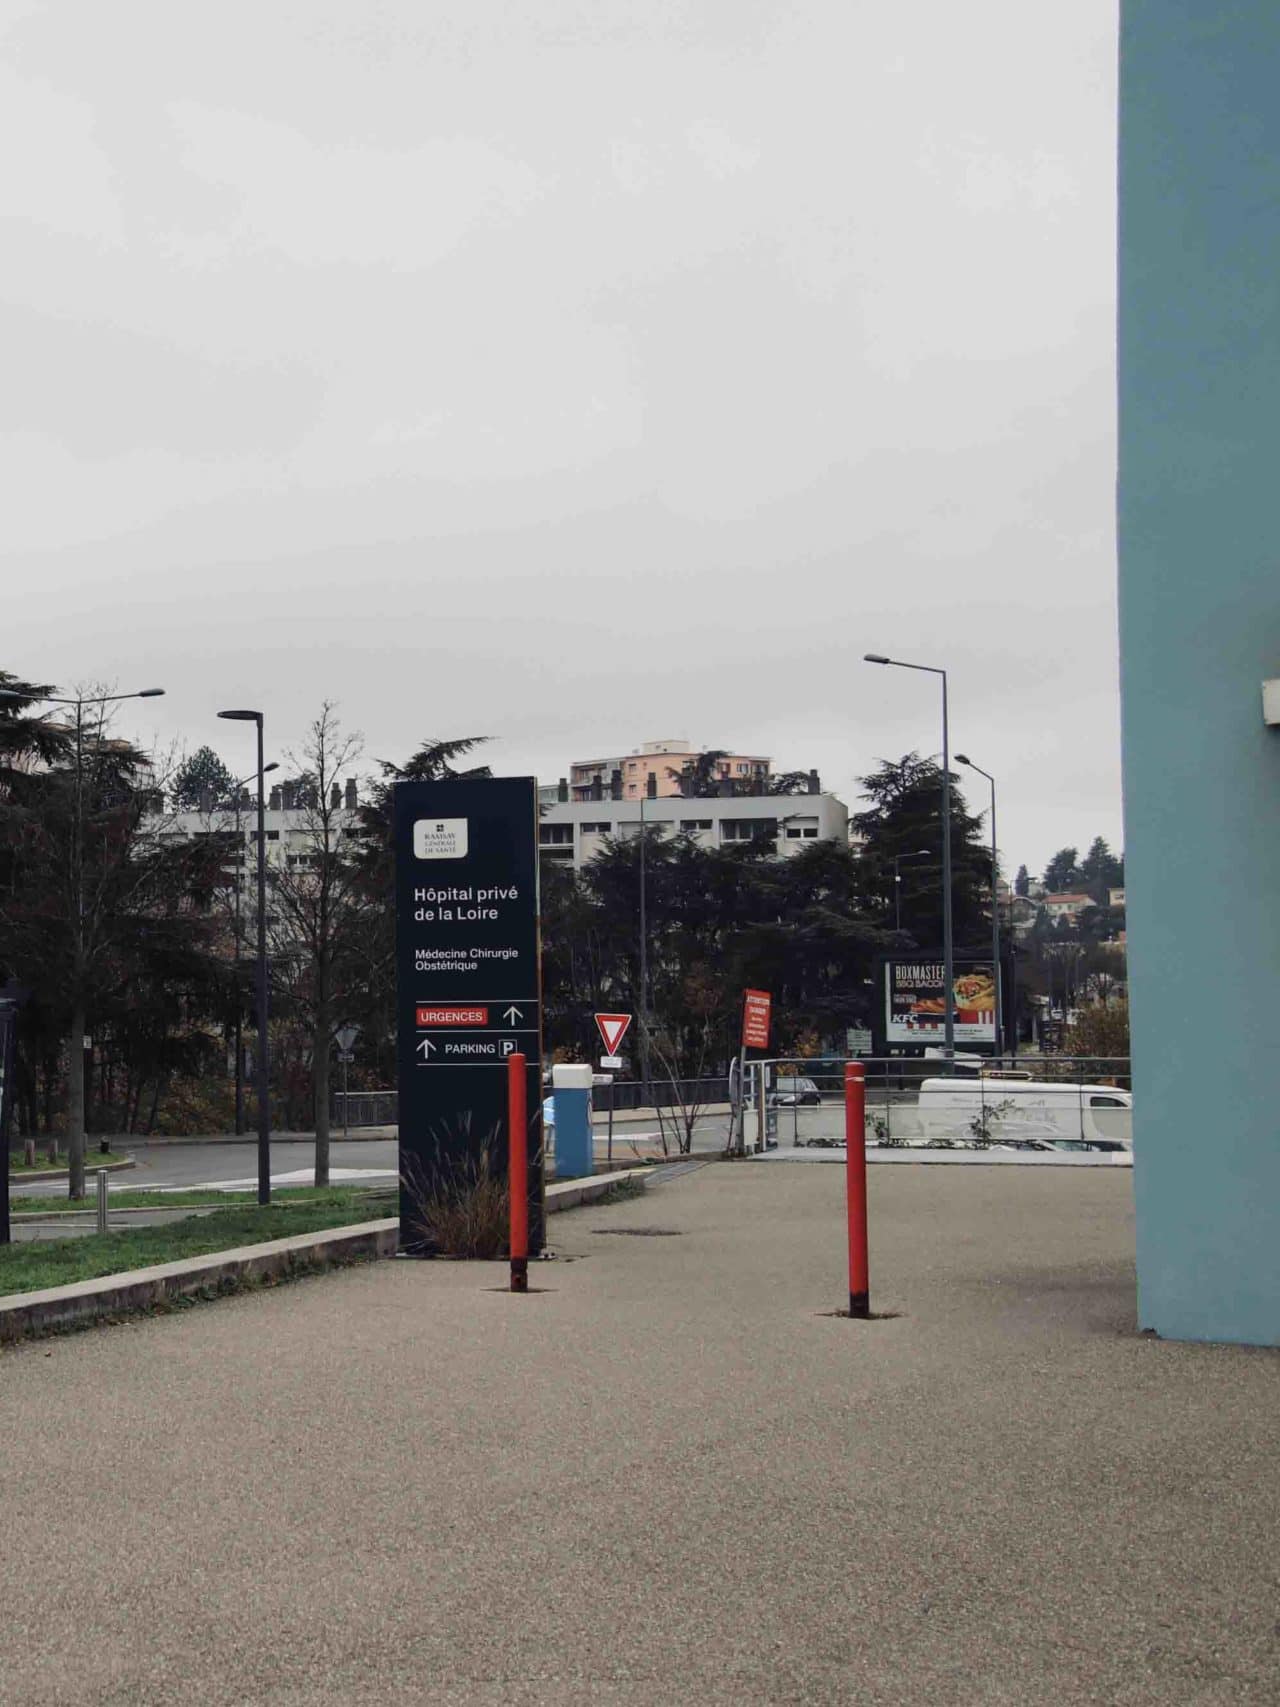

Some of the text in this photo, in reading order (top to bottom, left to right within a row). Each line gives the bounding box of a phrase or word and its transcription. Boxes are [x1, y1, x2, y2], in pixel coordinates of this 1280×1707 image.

[414, 885, 519, 904] Hôpital privé
[414, 906, 498, 921] de la Loire
[415, 947, 518, 960] Médecine Chirurgie
[415, 960, 478, 971] Obstétrique
[421, 1011, 483, 1022] URGENCES
[892, 1014, 919, 1023] KFC
[445, 1041, 514, 1056] PARKING P
